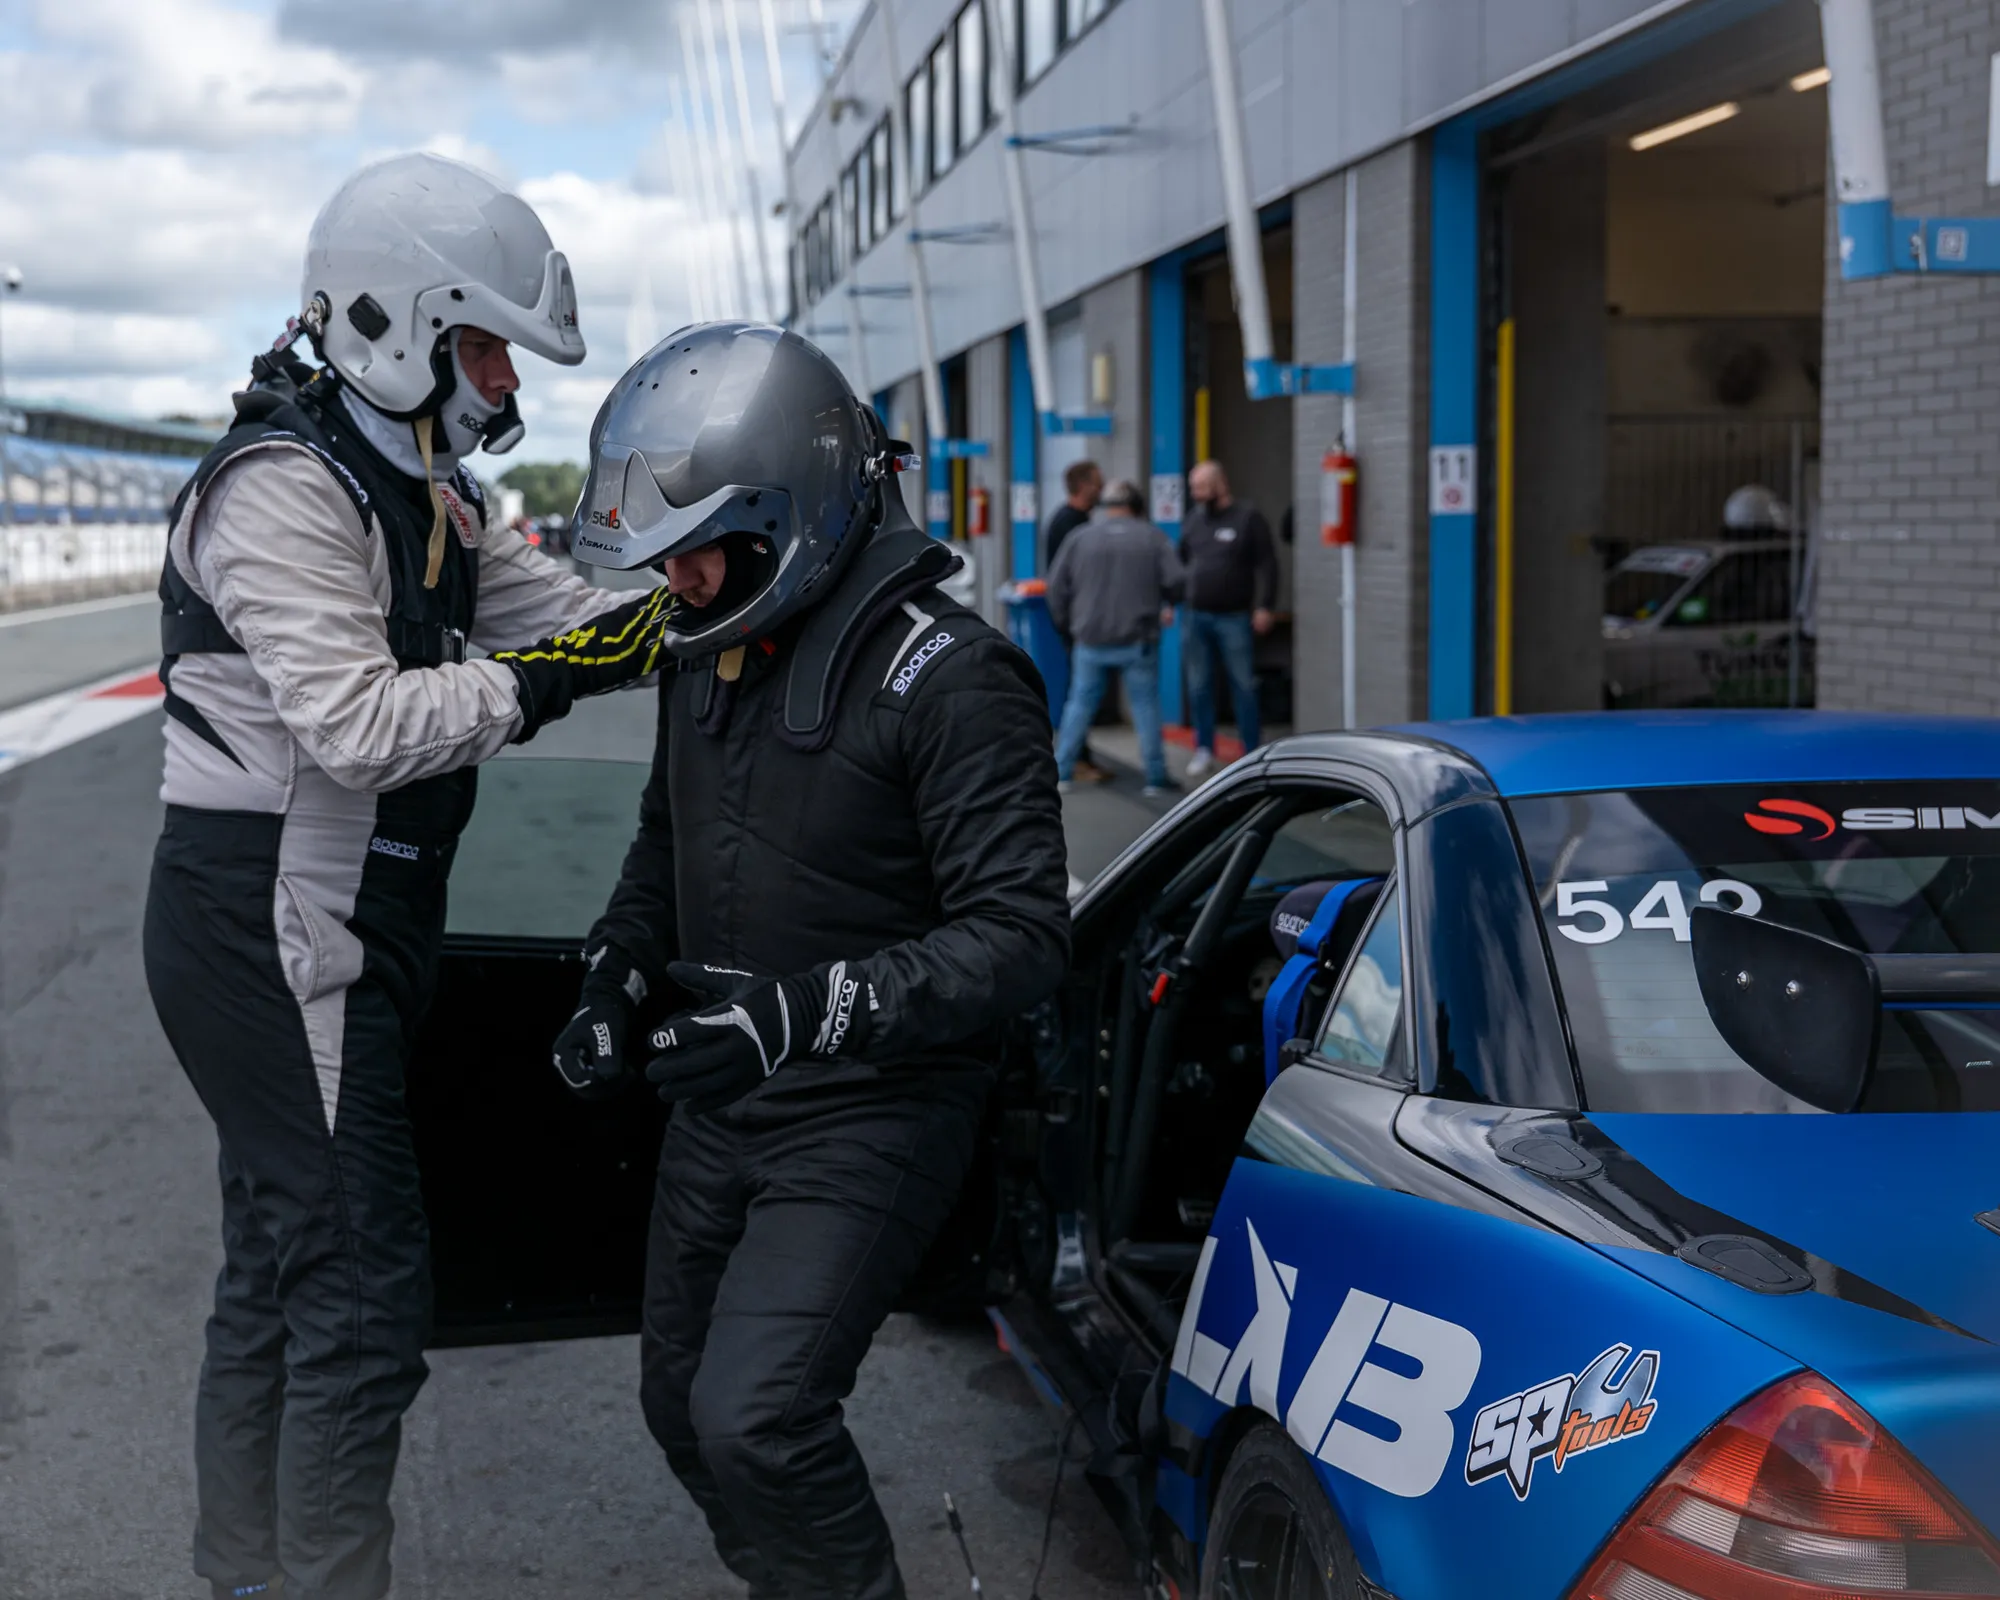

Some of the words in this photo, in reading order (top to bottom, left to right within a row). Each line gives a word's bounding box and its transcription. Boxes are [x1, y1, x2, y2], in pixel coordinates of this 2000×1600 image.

[1439, 454, 1469, 482] 11
[592, 507, 621, 530] Stilo
[585, 540, 603, 550] SIM
[892, 632, 955, 697] sparco
[1841, 806, 2000, 830] SIM
[370, 836, 420, 860] sparco
[1555, 1400, 1656, 1470] tools
